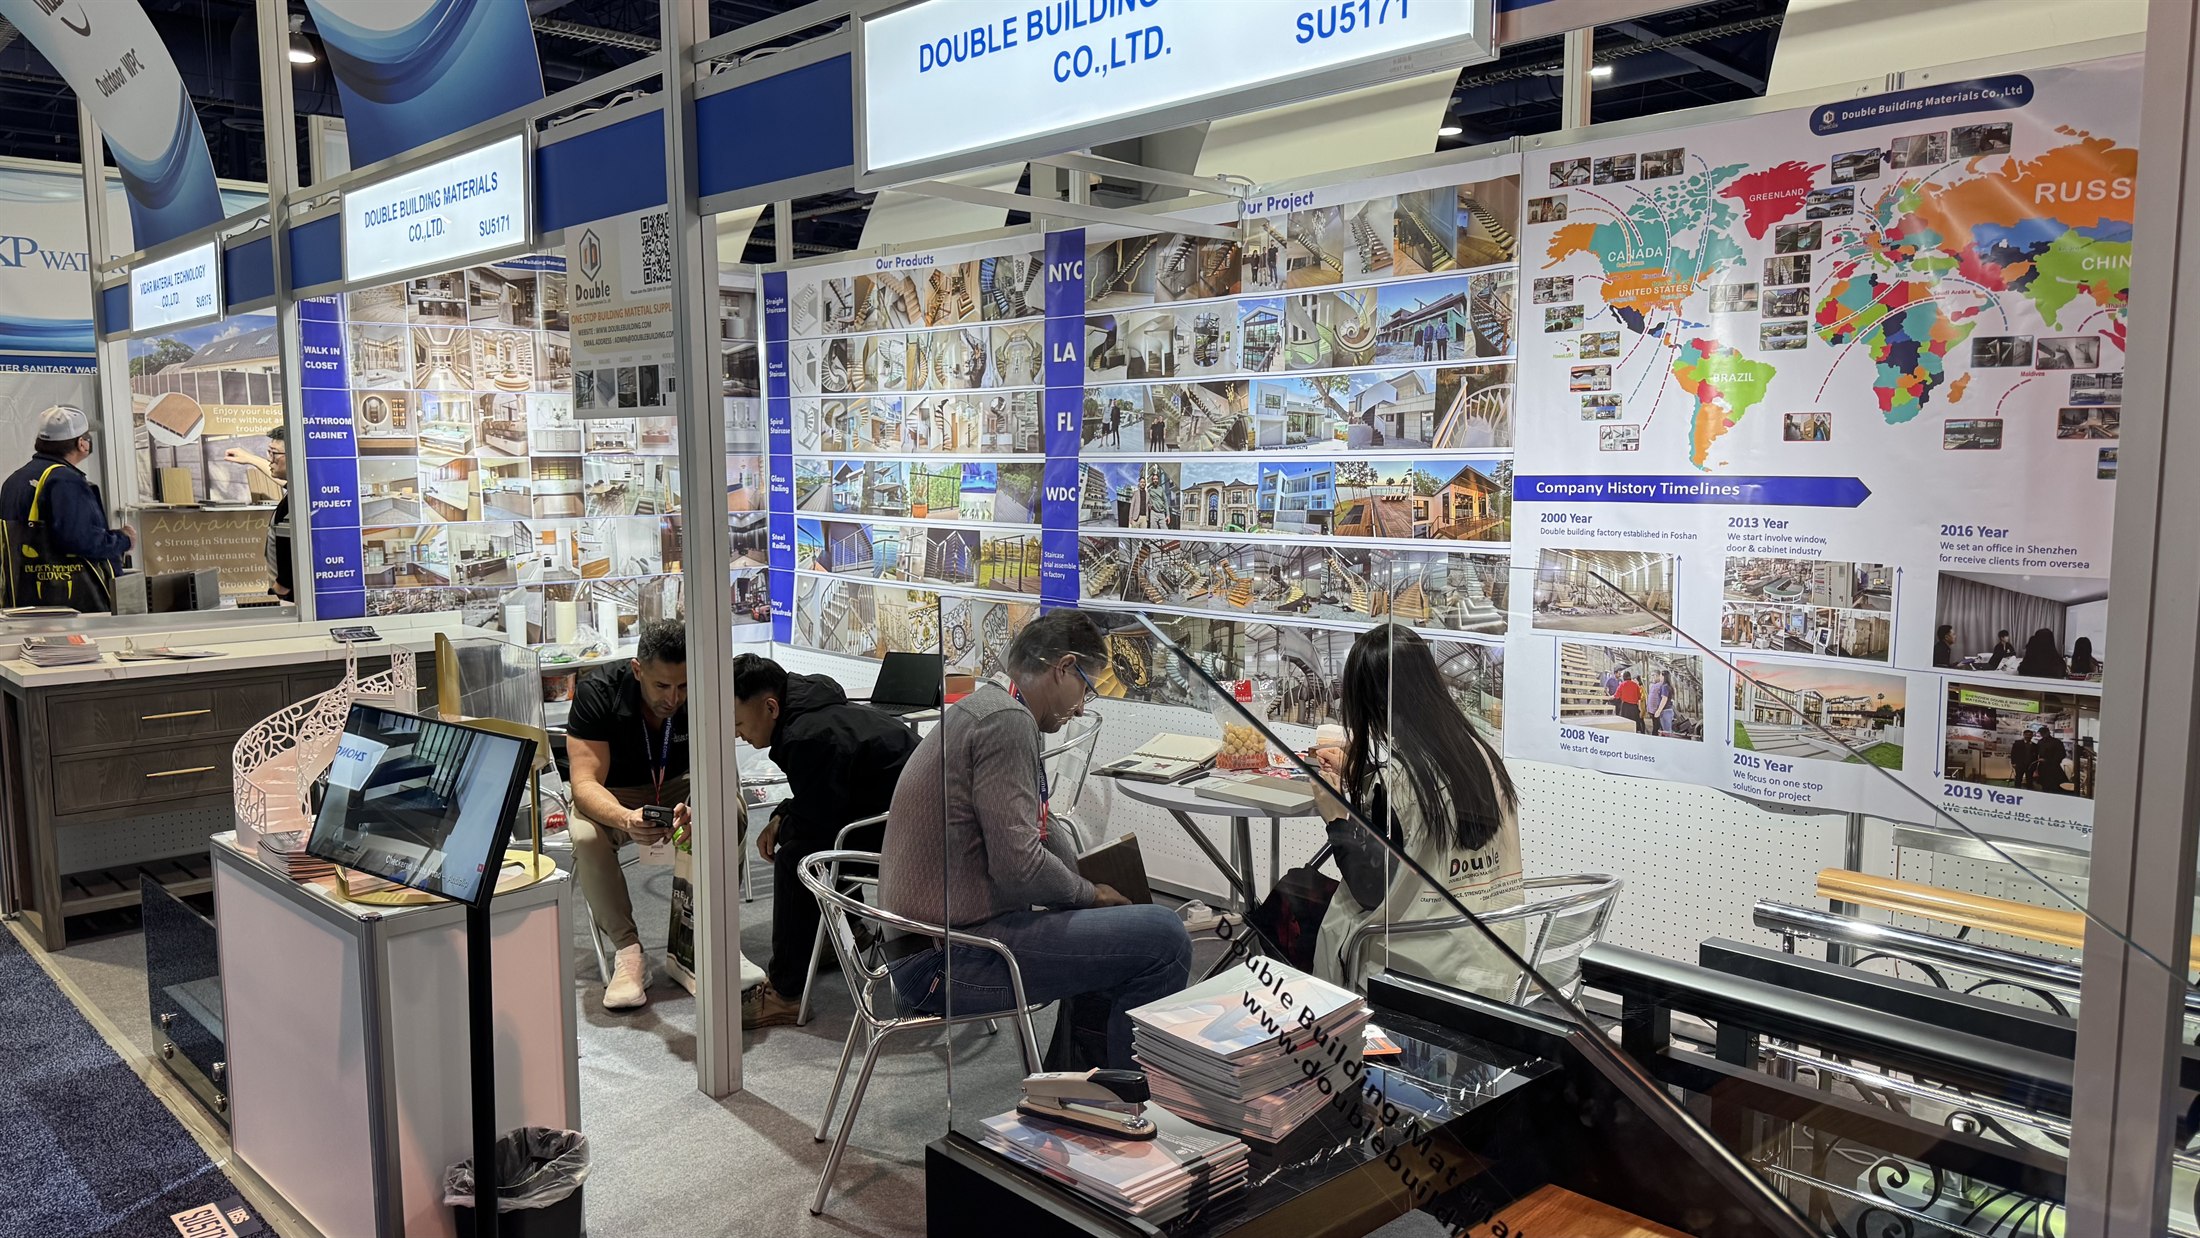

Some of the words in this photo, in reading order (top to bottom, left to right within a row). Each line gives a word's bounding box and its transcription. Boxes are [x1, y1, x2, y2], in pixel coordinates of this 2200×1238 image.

[1296, 0, 1411, 45] SU5171
[919, 16, 1018, 73] DOUBLE
[1026, 0, 1158, 55] BUILDIN
[1053, 25, 1172, 83] CO.,LTD.
[95, 67, 128, 97] Outdoor
[119, 48, 145, 78] WPC
[1841, 106, 1876, 121] Double
[1878, 100, 1923, 115] Building
[1925, 92, 1979, 107] Materials
[1981, 85, 2023, 101] Co.,Ltd
[365, 203, 397, 228] DOUBLE
[400, 190, 441, 218] BUILDING
[443, 172, 498, 204] MATERIALS
[1266, 191, 1314, 212] Project
[1749, 188, 1804, 202] GREENLAND
[408, 218, 445, 242] CO.,LTD.
[479, 215, 510, 237] SU5171
[1608, 247, 1663, 262] CANADA
[876, 258, 894, 270] Our
[896, 254, 934, 268] Products
[153, 275, 174, 292] MATERIAL
[174, 264, 206, 285] TECHNOLOGY
[1048, 260, 1083, 283] NYC
[575, 280, 611, 301] Double
[1620, 288, 1652, 297] UNITED
[1654, 284, 1688, 294] STATES
[571, 314, 582, 324] ONE
[584, 313, 597, 323] STOP
[598, 309, 624, 321] BUILDING
[304, 346, 329, 356] WALK
[330, 346, 340, 356] IN
[1053, 342, 1076, 363] LA
[22, 365, 72, 374] SANITARY
[305, 361, 338, 370] CLOSET
[1713, 372, 1754, 383] BRAZIL
[213, 407, 238, 416] Enjoy
[240, 408, 260, 416] your
[239, 416, 273, 424] without
[302, 416, 352, 426] BATHROOM
[770, 418, 784, 426] Spiral
[1058, 412, 1074, 432] FL
[308, 430, 348, 440] CABINET
[770, 426, 790, 434] Staircase
[770, 474, 785, 482] Glass
[321, 486, 340, 494] OUR
[771, 484, 790, 494] Railing
[1046, 486, 1076, 502] WDC
[1536, 482, 1603, 498] Company
[1608, 482, 1656, 497] History
[1660, 482, 1740, 496] Timelines
[312, 499, 352, 508] PROJECT
[1540, 513, 1567, 523] 2000
[1570, 514, 1592, 524] Year
[1728, 517, 1759, 528] 2013
[1762, 518, 1788, 530] Year
[772, 534, 786, 542] Steel
[1566, 528, 1595, 538] building
[1596, 529, 1622, 538] factory
[1623, 530, 1660, 539] established
[1662, 531, 1668, 539] in
[1670, 531, 1698, 540] Foshan
[1940, 524, 1974, 537] 2016
[1977, 526, 2009, 538] Year
[164, 538, 200, 548] Strong
[202, 538, 212, 546] in
[213, 536, 262, 545] Structure
[1727, 532, 1740, 540] We
[1742, 534, 1762, 542] start
[1764, 534, 1793, 542] involve
[1794, 534, 1828, 545] window,
[772, 542, 791, 551] Railing
[1726, 544, 1746, 552] door
[1748, 544, 1756, 552] &
[1757, 545, 1788, 554] cabinet
[1788, 546, 1822, 557] industry
[1940, 542, 1954, 550] We
[1956, 543, 1970, 551] set
[1972, 544, 1984, 552] an
[1986, 542, 2013, 553] office
[2015, 545, 2025, 554] in
[2027, 545, 2078, 556] Shenzhen
[166, 554, 187, 562] Low
[190, 552, 256, 561] Maintenance
[325, 556, 345, 566] OUR
[1044, 551, 1065, 559] Staircase
[1939, 554, 1952, 562] for
[1954, 556, 1986, 565] receive
[1988, 556, 2020, 566] clients
[2022, 558, 2047, 568] from
[2049, 561, 2090, 570] oversea
[1054, 562, 1077, 570] assemble
[37, 572, 72, 580] GLOVES
[316, 570, 356, 580] PROJECT
[1048, 571, 1066, 580] factory
[1560, 728, 1585, 740] 2008
[1588, 731, 1610, 744] Year
[1560, 742, 1571, 751] We
[1572, 745, 1588, 753] start
[1590, 746, 1598, 754] do
[1600, 749, 1622, 758] export
[1624, 752, 1656, 762] business
[1733, 753, 1760, 768] 2015
[1764, 758, 1794, 773] Year
[1733, 770, 1746, 779] We
[1747, 772, 1767, 784] focus
[1768, 778, 1780, 786] on
[1782, 780, 1800, 788] one
[1802, 781, 1824, 792] stop
[1732, 782, 1762, 796] solution
[1764, 788, 1776, 798] for
[1778, 791, 1812, 802] project
[1944, 783, 1983, 800] 2019
[1986, 789, 2024, 806] Year
[1942, 802, 1960, 813] We
[1962, 806, 2012, 820] attended
[1449, 847, 1500, 878] Double
[1214, 915, 1294, 1010] Double
[1297, 1004, 1401, 1128] Building
